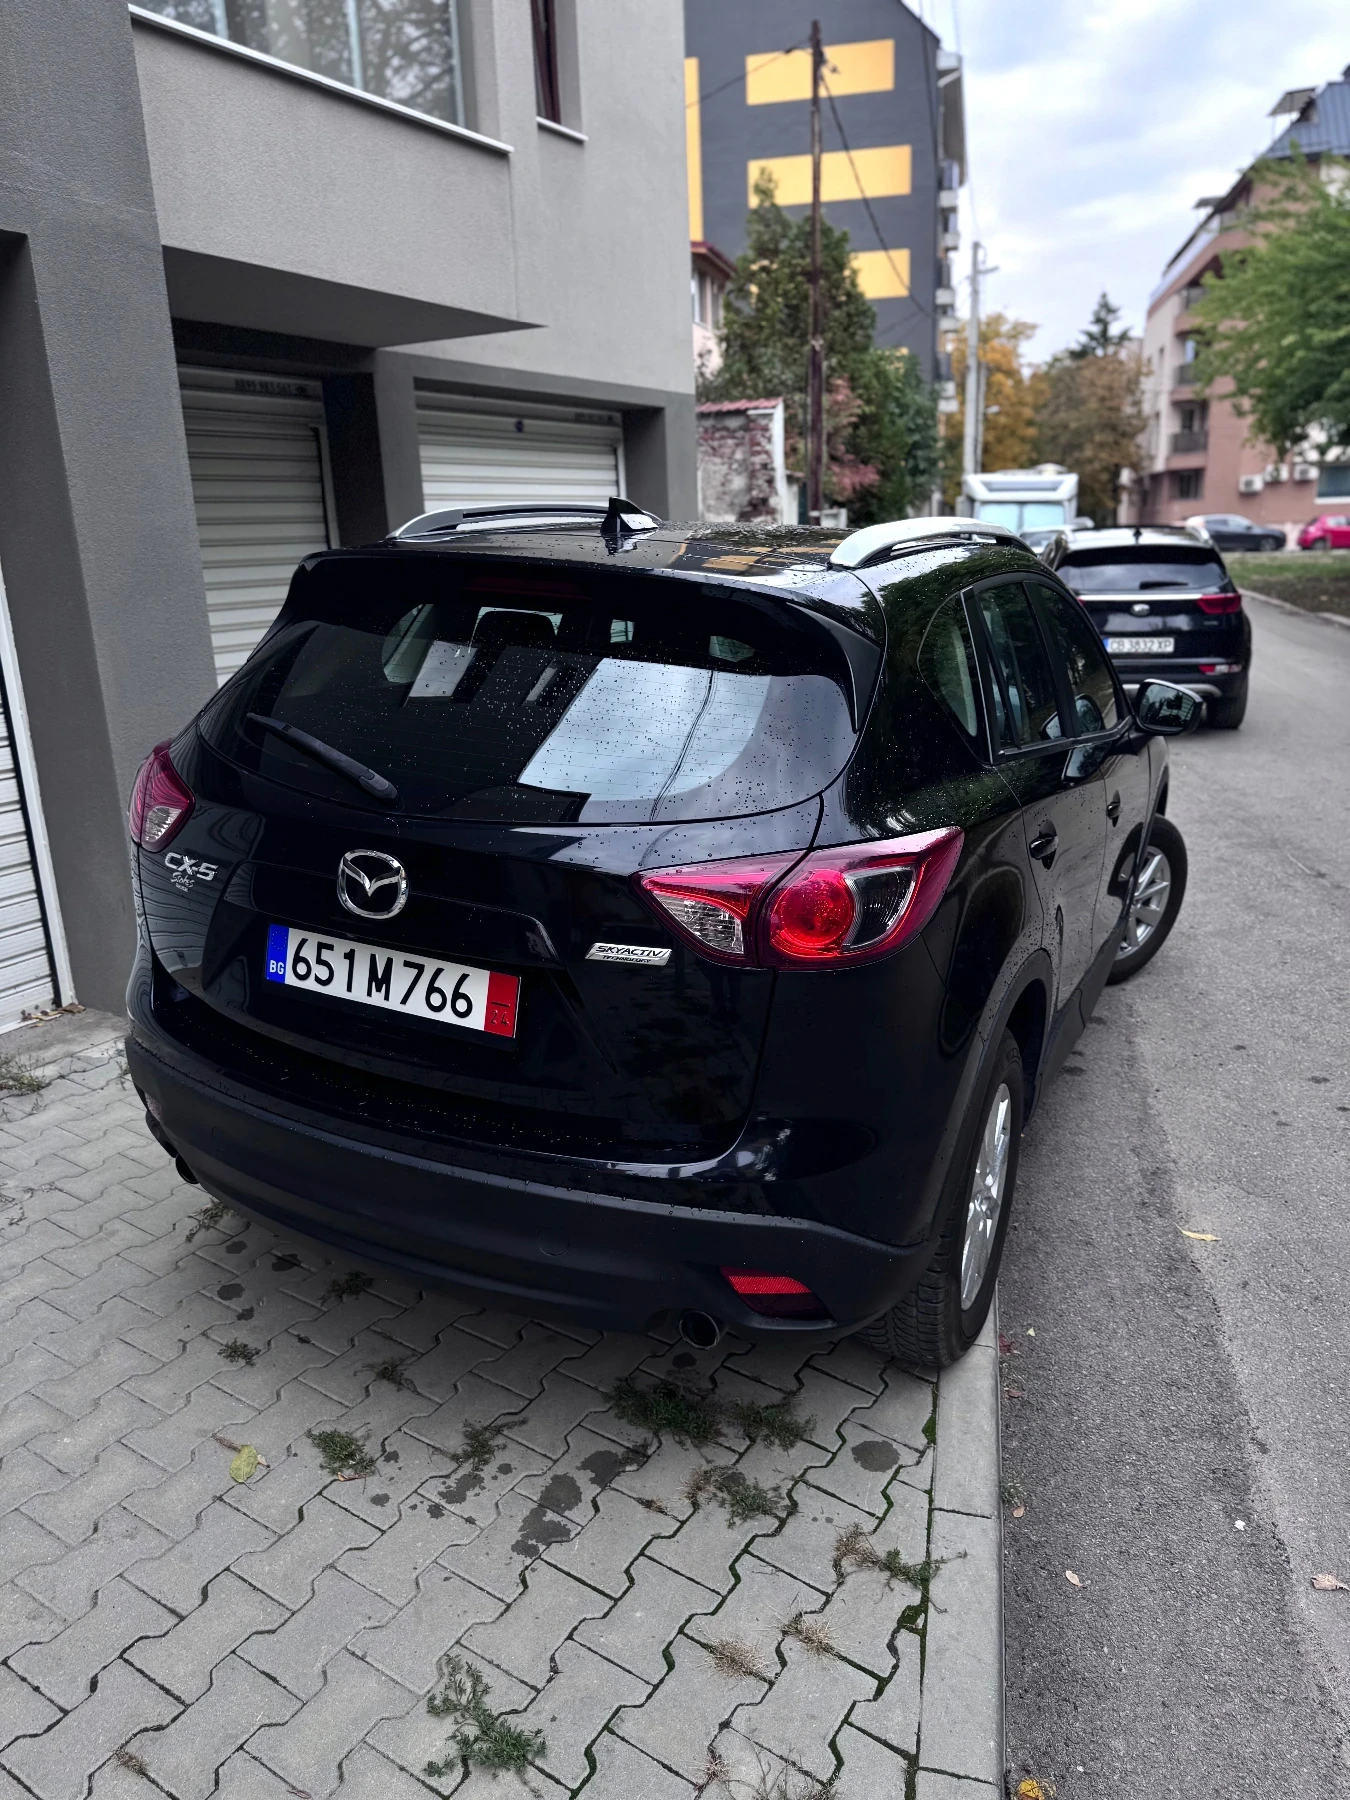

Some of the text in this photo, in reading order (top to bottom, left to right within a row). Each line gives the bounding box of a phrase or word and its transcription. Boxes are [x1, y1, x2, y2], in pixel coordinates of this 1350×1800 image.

[164, 852, 218, 881] CX-5
[595, 945, 663, 957] SKYACTIV
[269, 959, 285, 975] BG
[292, 937, 473, 1019] 651M766
[489, 1009, 511, 1026] 24
